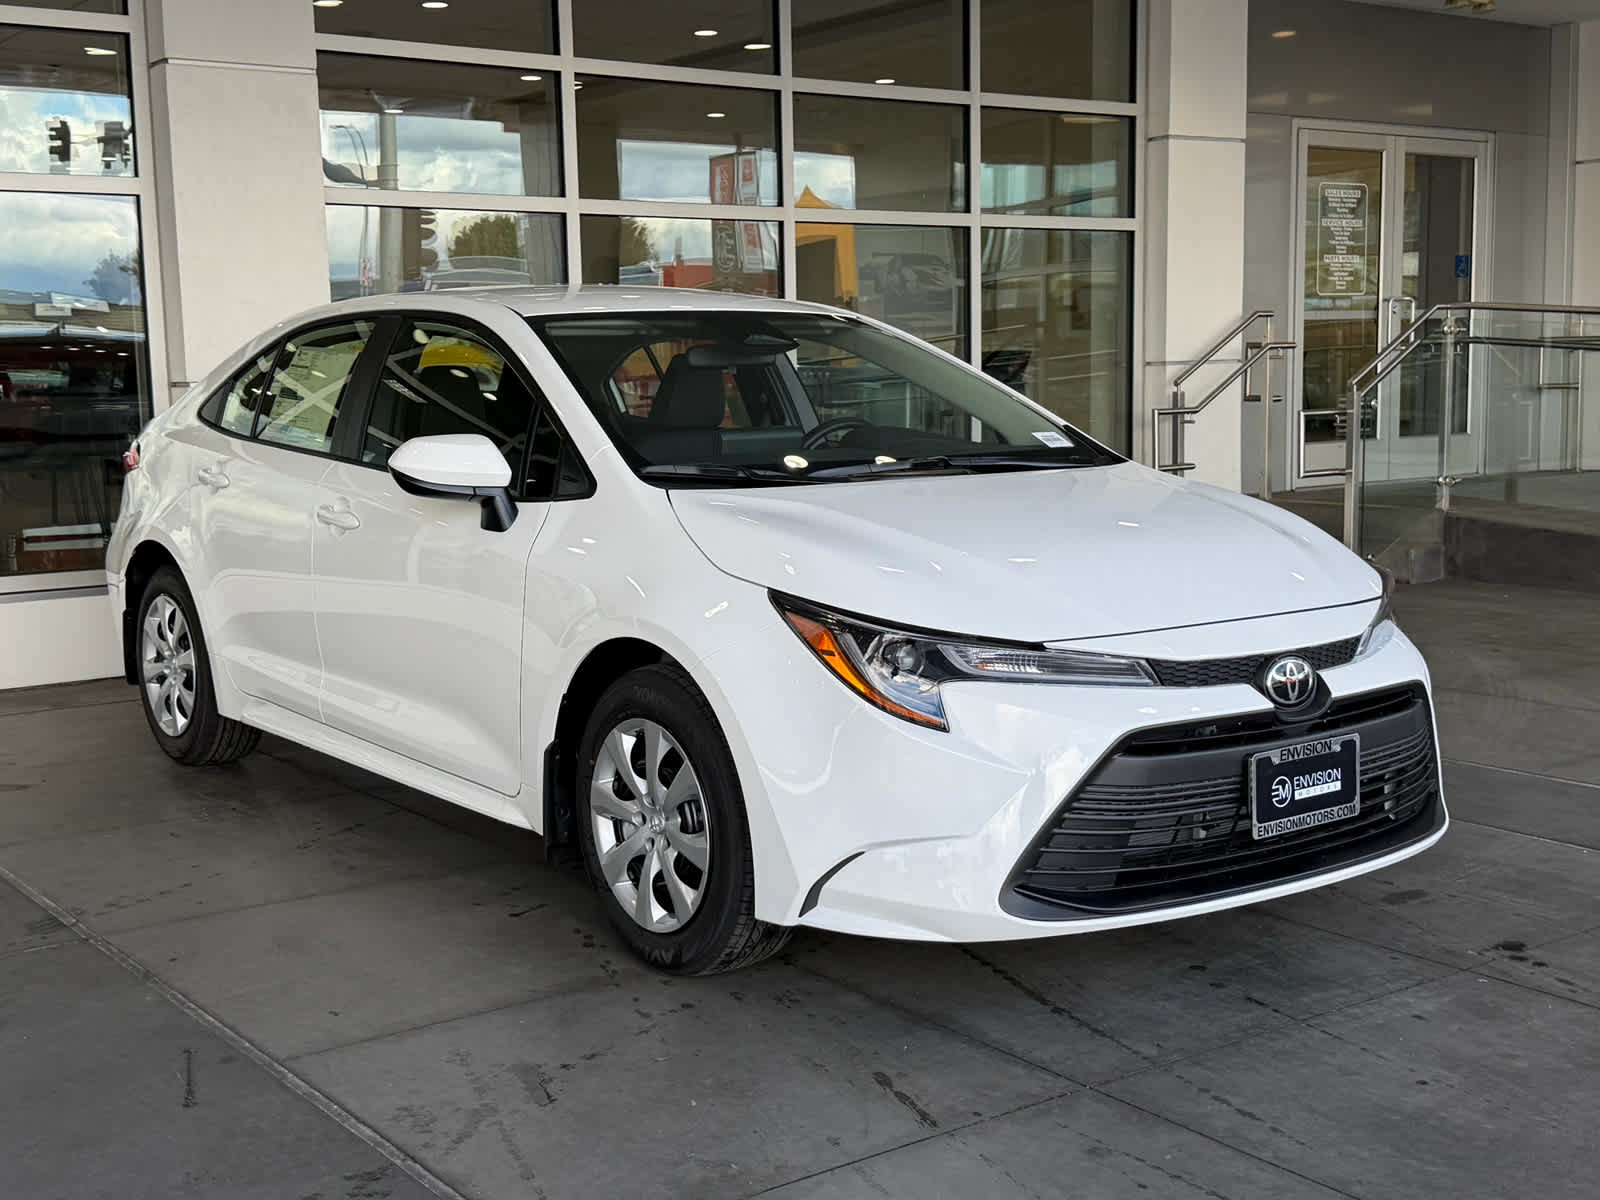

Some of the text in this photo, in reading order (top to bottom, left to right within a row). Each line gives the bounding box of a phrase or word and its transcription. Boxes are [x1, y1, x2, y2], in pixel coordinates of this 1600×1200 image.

[1280, 740, 1332, 761] ENVISION
[1294, 768, 1341, 790] ENVISION
[1257, 804, 1356, 838] ENVISIONMOTORS.COM
